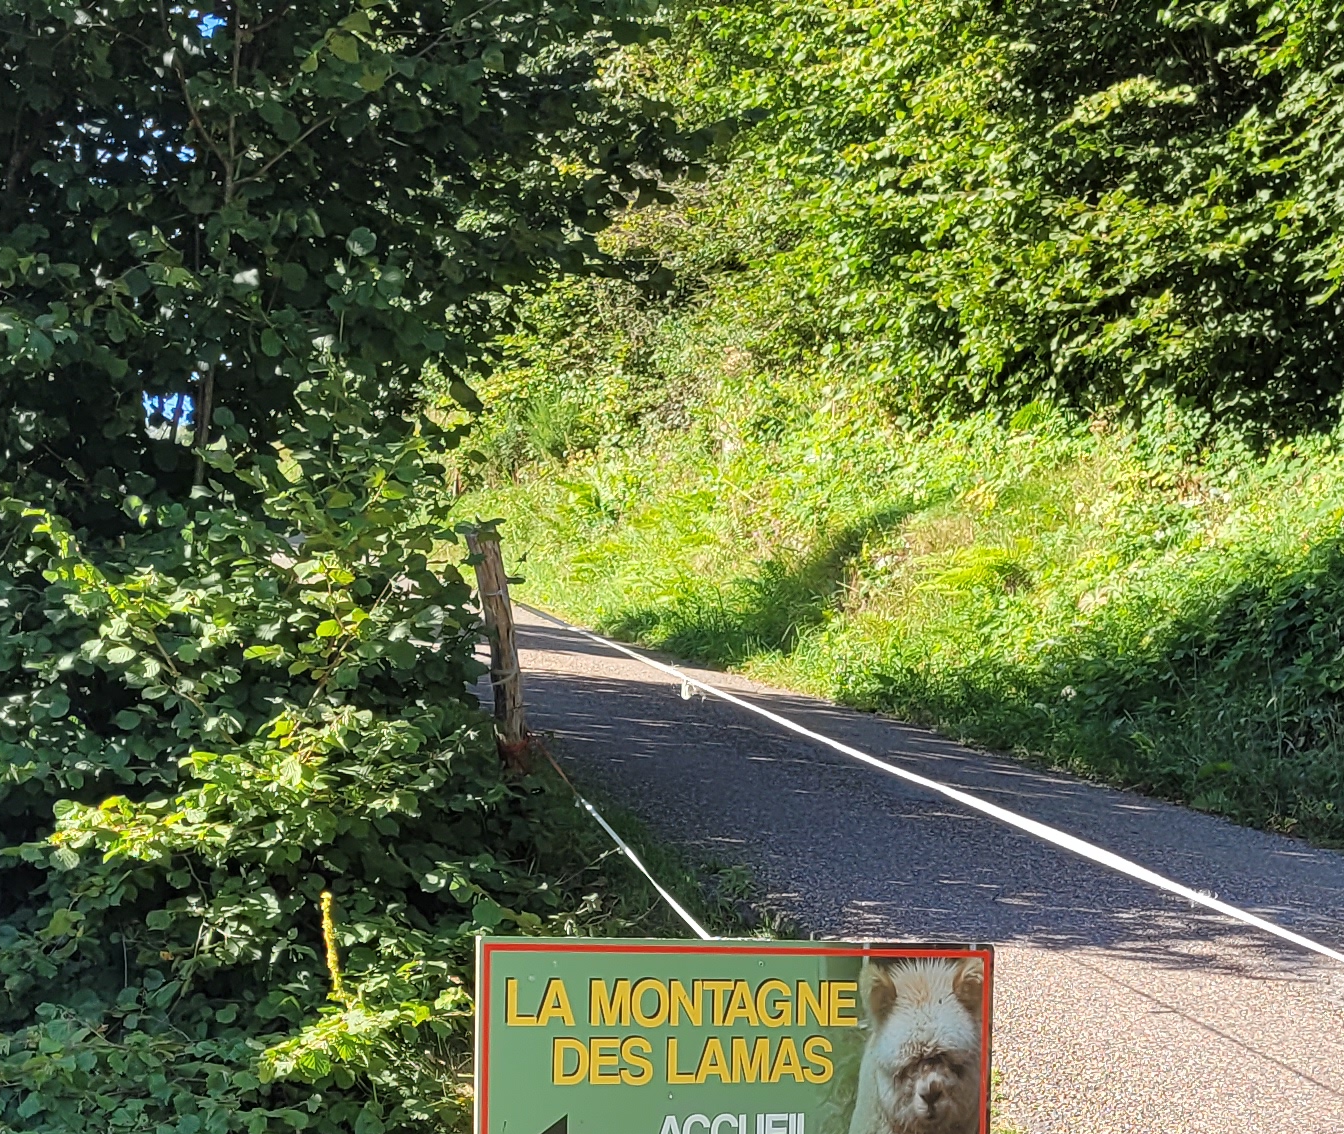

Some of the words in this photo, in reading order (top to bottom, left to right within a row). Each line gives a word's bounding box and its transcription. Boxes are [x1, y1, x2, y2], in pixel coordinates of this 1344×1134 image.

[506, 977, 574, 1027] LA
[588, 977, 858, 1027] MONTAGNE
[553, 1036, 653, 1086] DES
[666, 1036, 834, 1085] LAMAS
